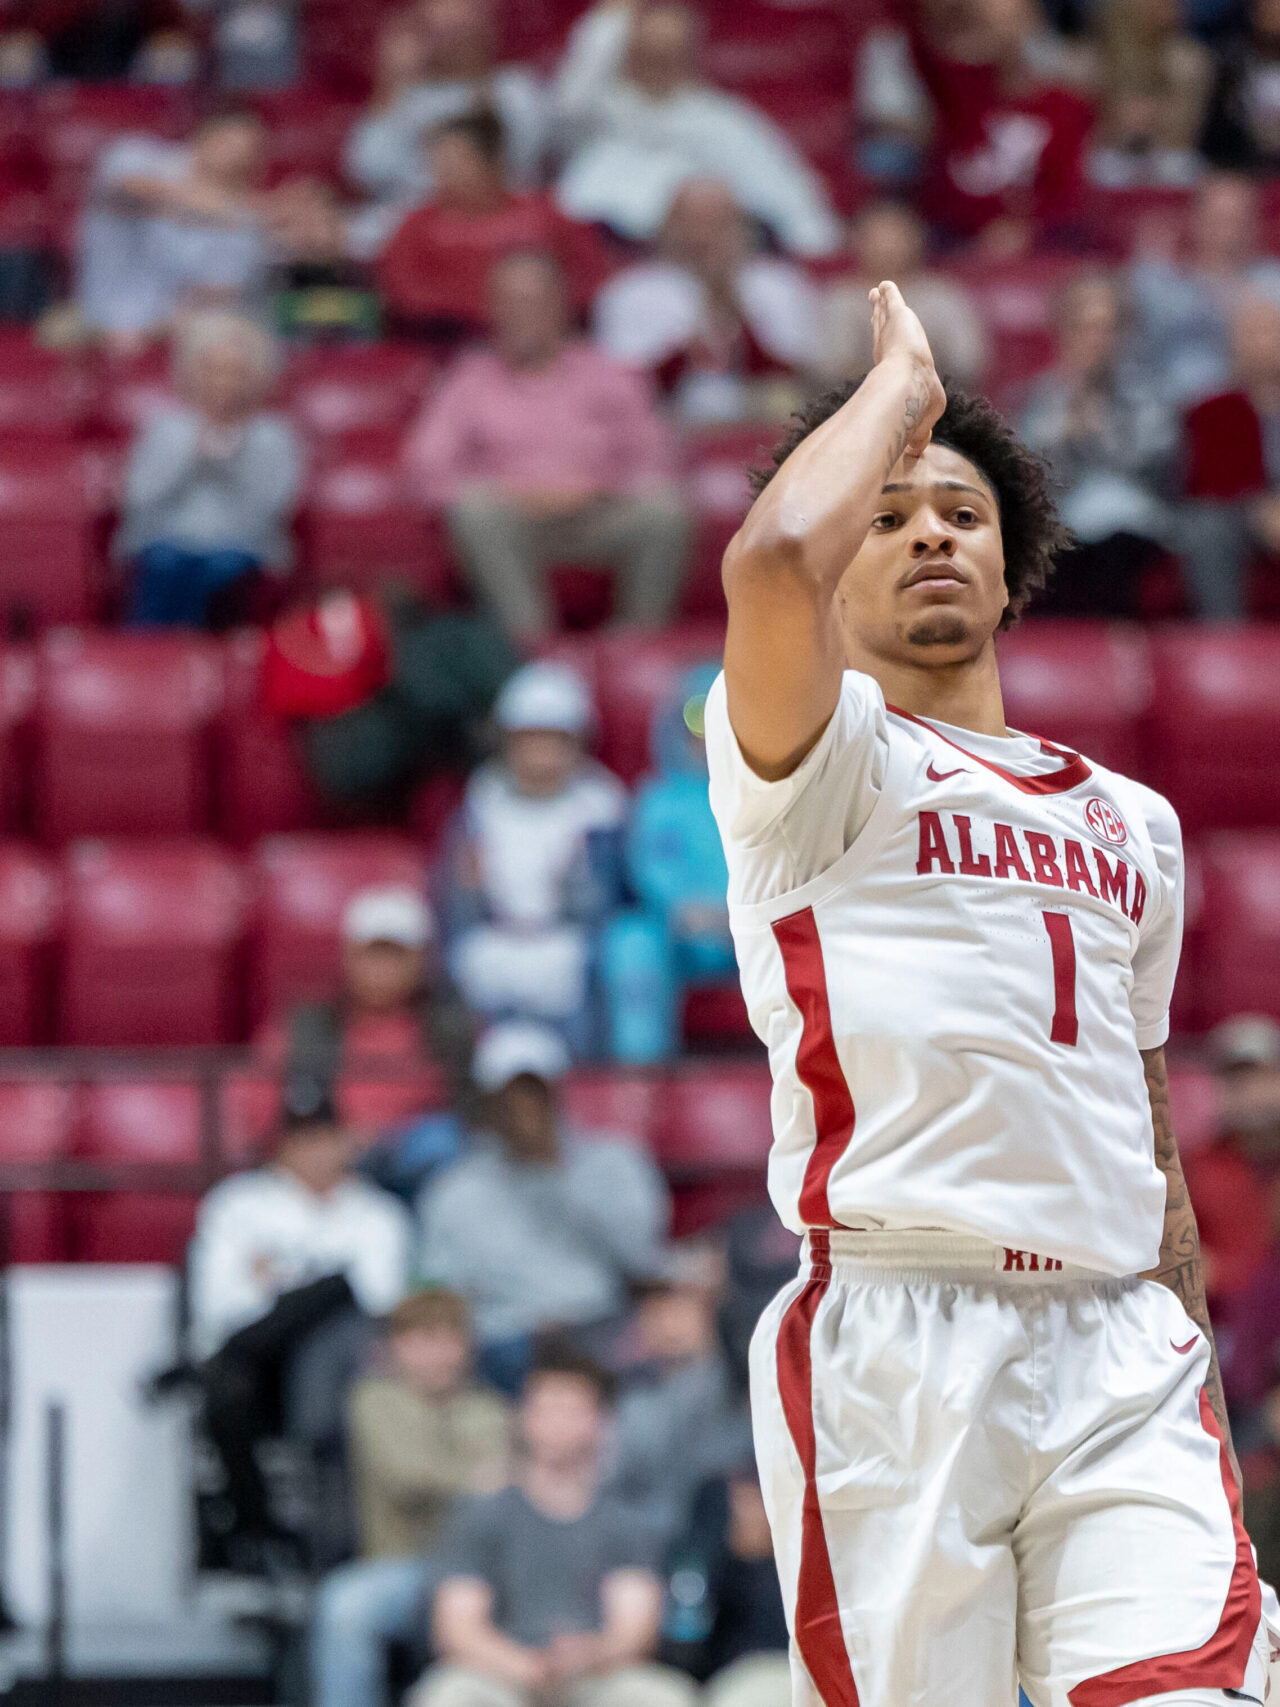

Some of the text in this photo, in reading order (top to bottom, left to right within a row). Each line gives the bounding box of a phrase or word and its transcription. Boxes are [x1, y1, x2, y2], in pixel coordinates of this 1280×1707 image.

[916, 811, 1146, 928] ALABAMA
[1085, 798, 1127, 843] SEC
[1042, 910, 1079, 1046] 1
